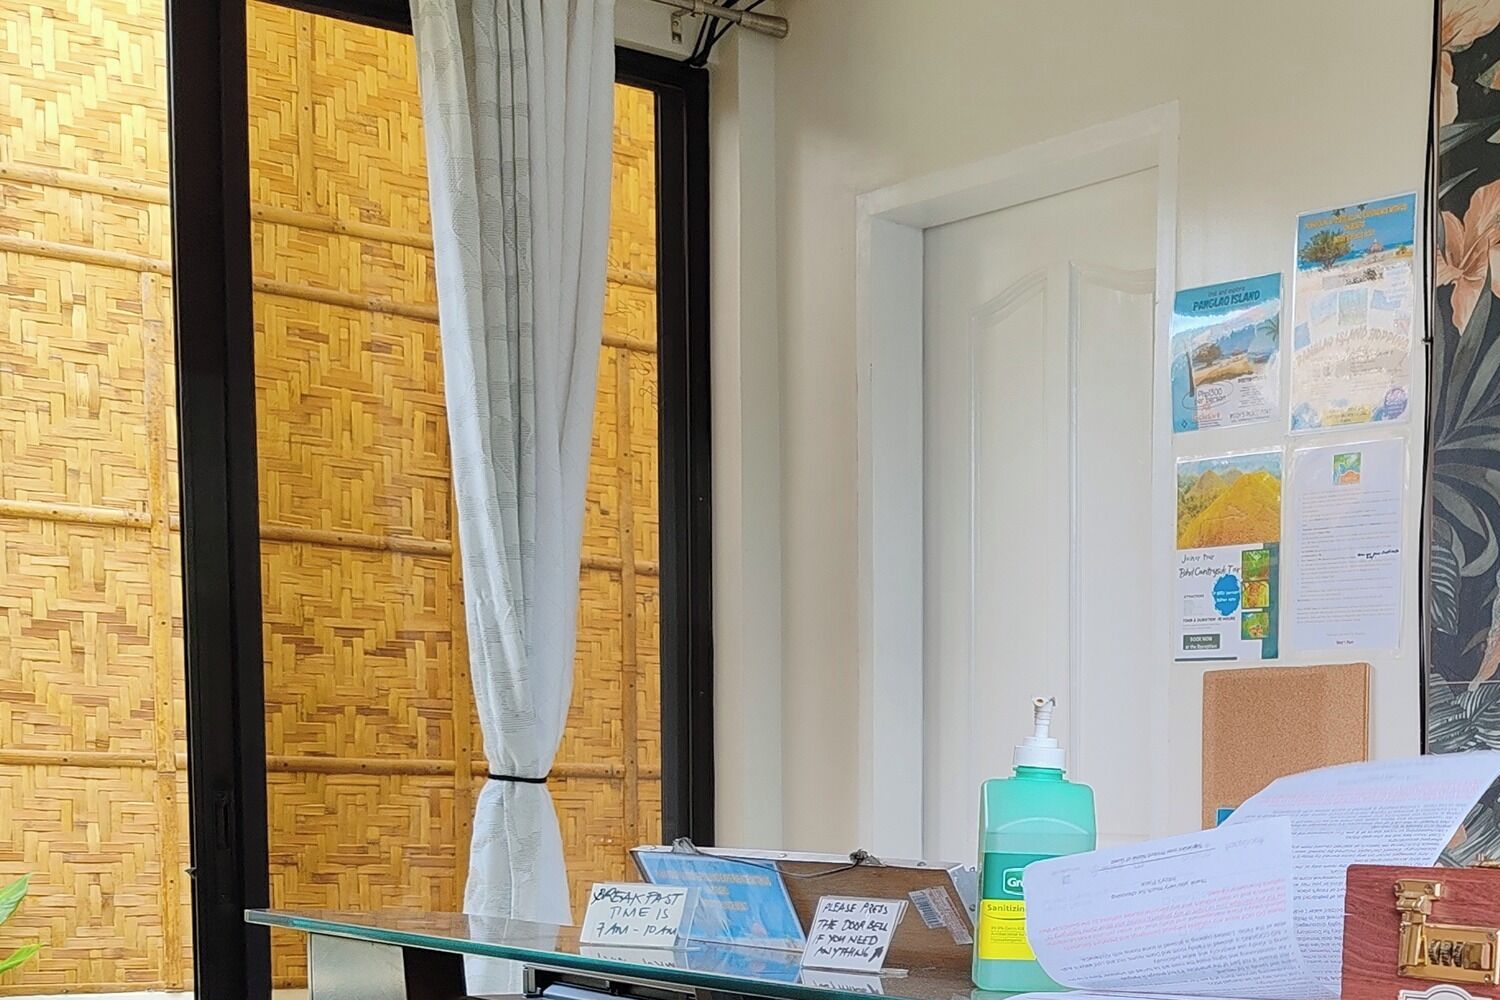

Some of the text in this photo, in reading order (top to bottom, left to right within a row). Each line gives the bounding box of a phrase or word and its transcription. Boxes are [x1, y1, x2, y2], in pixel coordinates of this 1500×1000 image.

[1193, 290, 1260, 311] PANGLAO ISLAND
[610, 905, 669, 920] TIME IS
[823, 901, 889, 914] PLEASE PRESS
[987, 904, 1025, 912] Sanitizin
[817, 919, 889, 932] THE DOOR BELL
[813, 934, 879, 946] IF YOU NEED
[814, 946, 870, 959] ANYTHING
